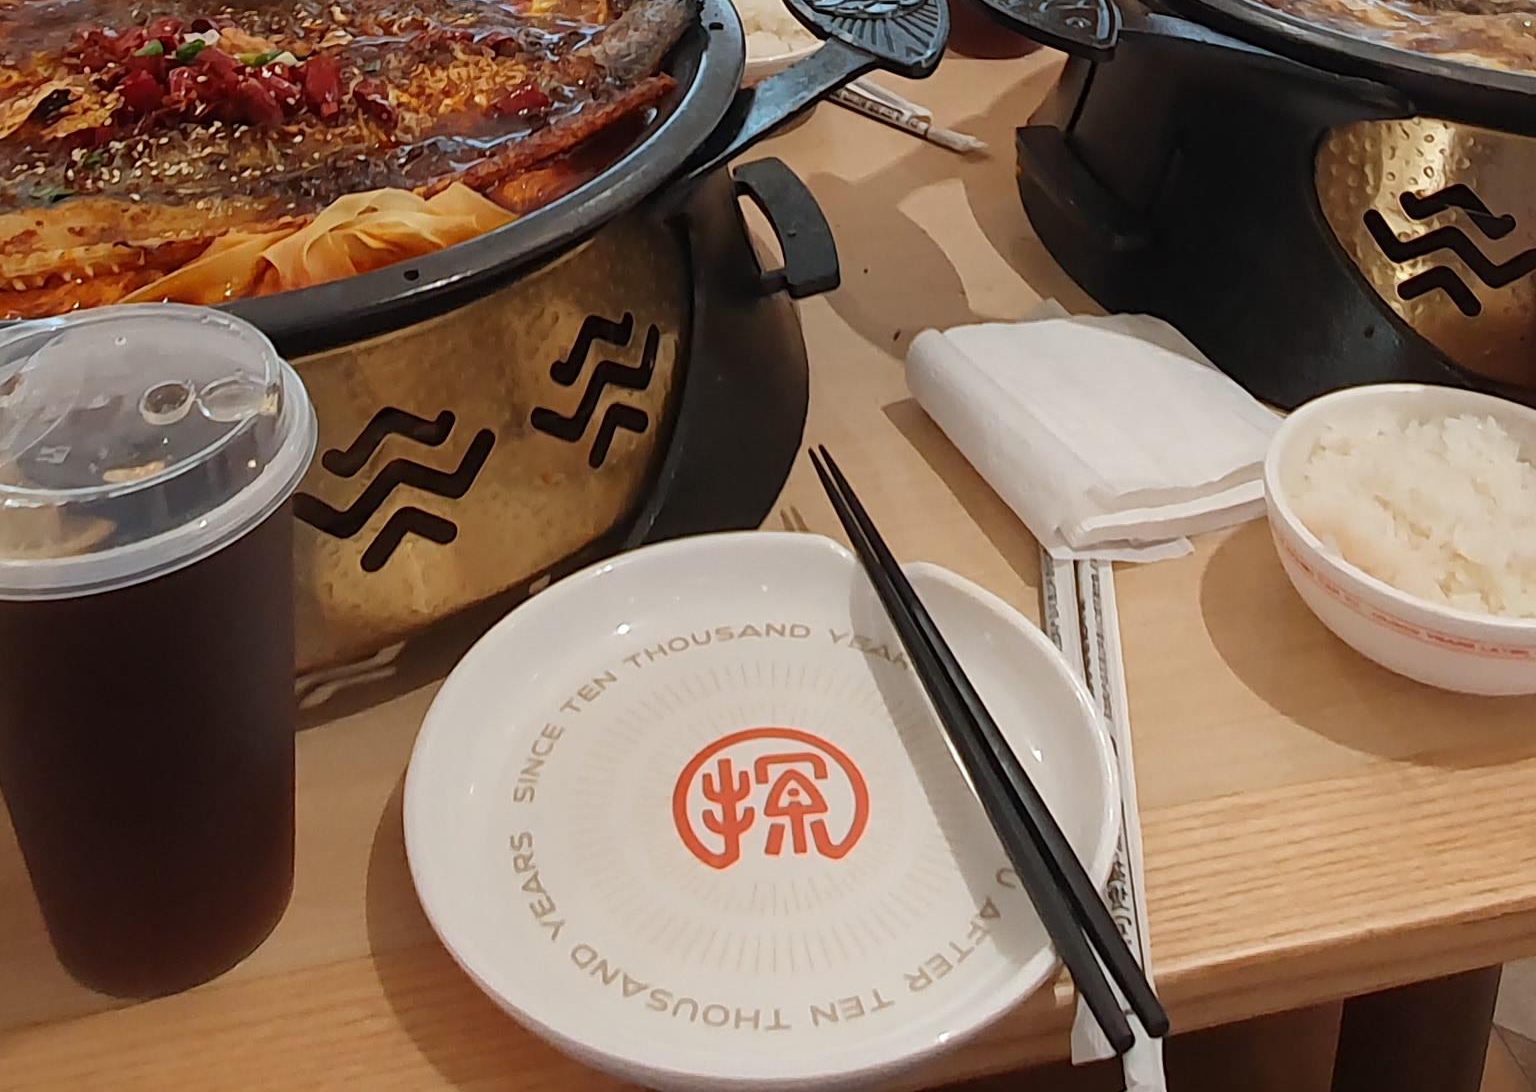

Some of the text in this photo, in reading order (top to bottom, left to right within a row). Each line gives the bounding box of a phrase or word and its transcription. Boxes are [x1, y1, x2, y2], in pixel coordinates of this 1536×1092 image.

[513, 722, 565, 804] SINCE
[559, 669, 618, 713] TEN
[622, 622, 811, 669] THOUSAND
[509, 831, 566, 942] YEARS
[570, 943, 792, 1032] THOUSAND
[809, 988, 896, 1027] TEN
